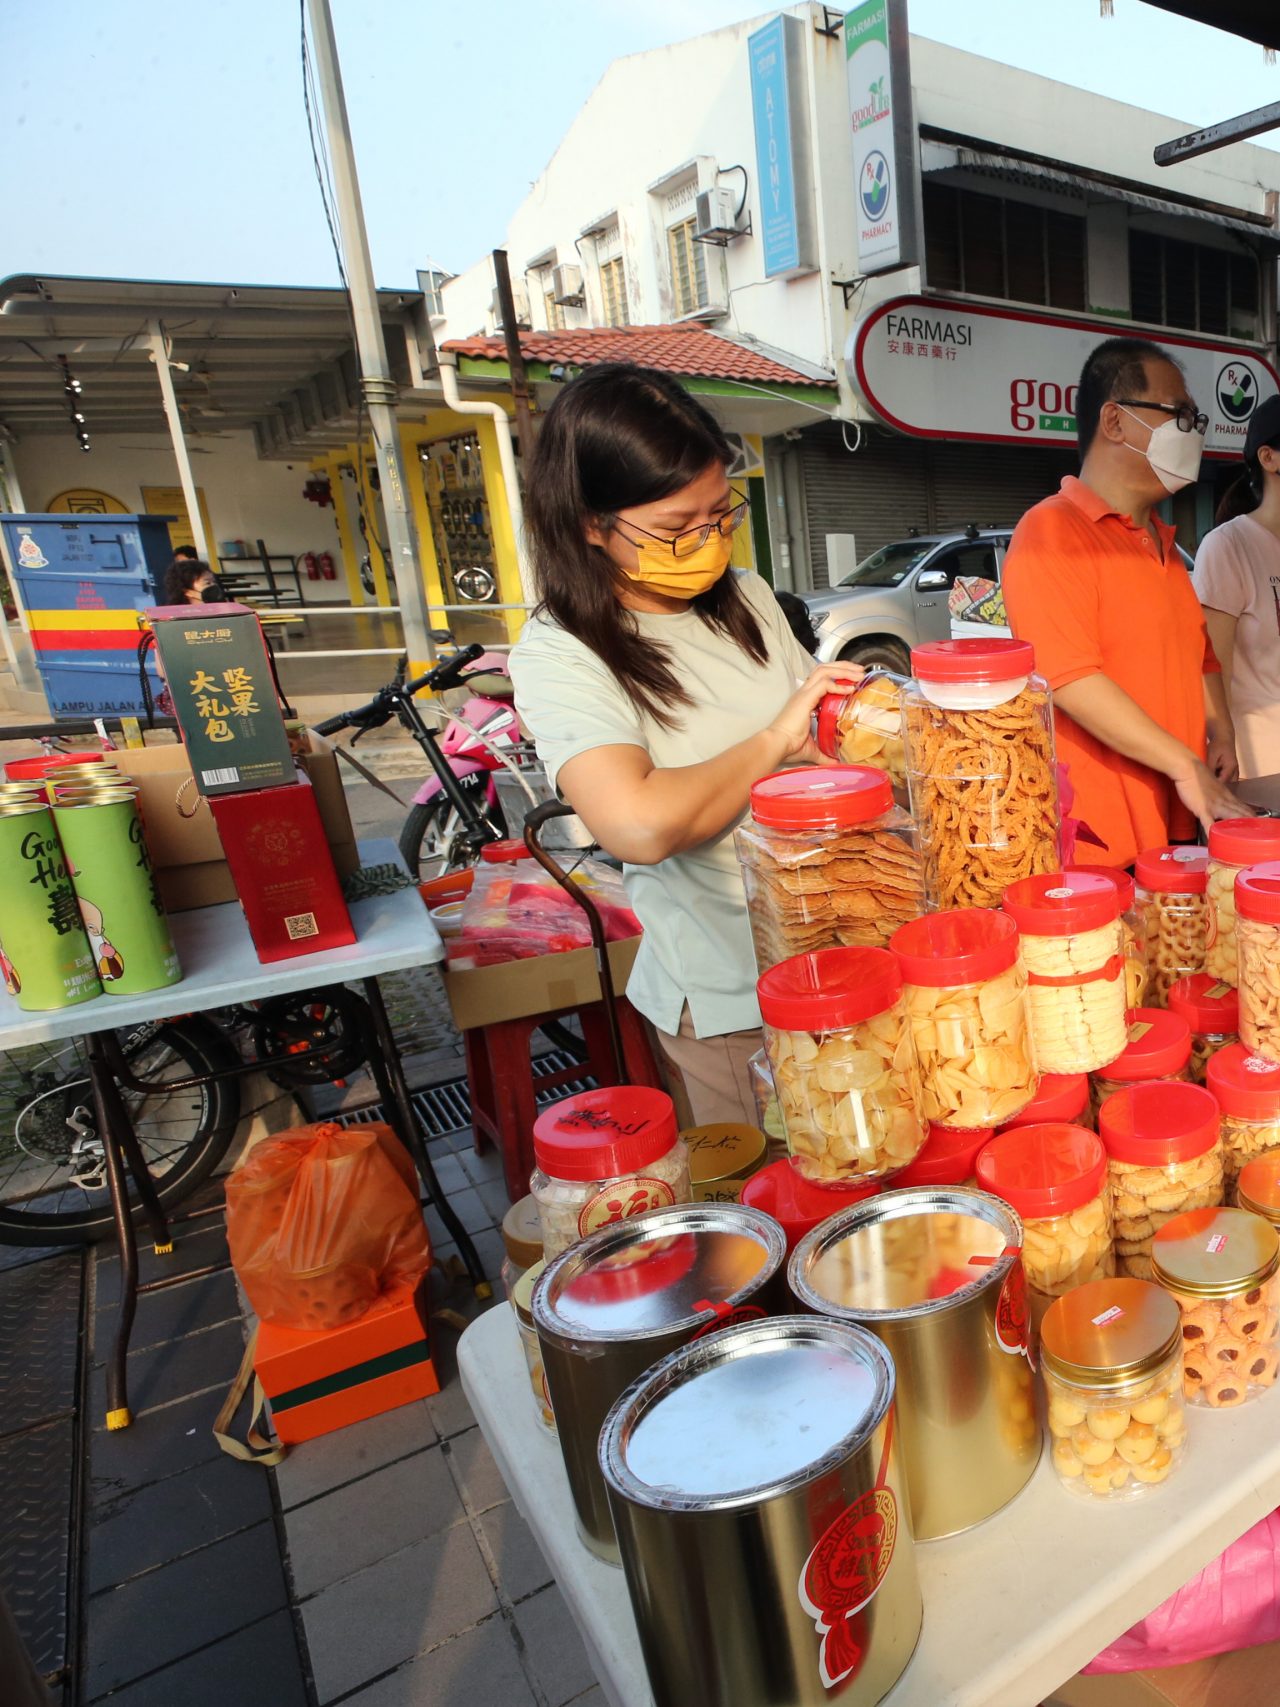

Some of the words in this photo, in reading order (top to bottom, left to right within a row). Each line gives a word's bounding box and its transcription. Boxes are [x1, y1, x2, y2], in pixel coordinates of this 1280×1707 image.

[846, 9, 886, 41] FARMASI
[765, 87, 780, 213] ATOMY
[861, 221, 893, 241] PHARMACY
[887, 315, 972, 346] FARMASI
[887, 340, 958, 361] 安康西藥行
[53, 699, 95, 713] LAMPU
[97, 700, 136, 713] JALAN
[189, 670, 236, 743] 大礼包
[222, 667, 261, 718] 坚果
